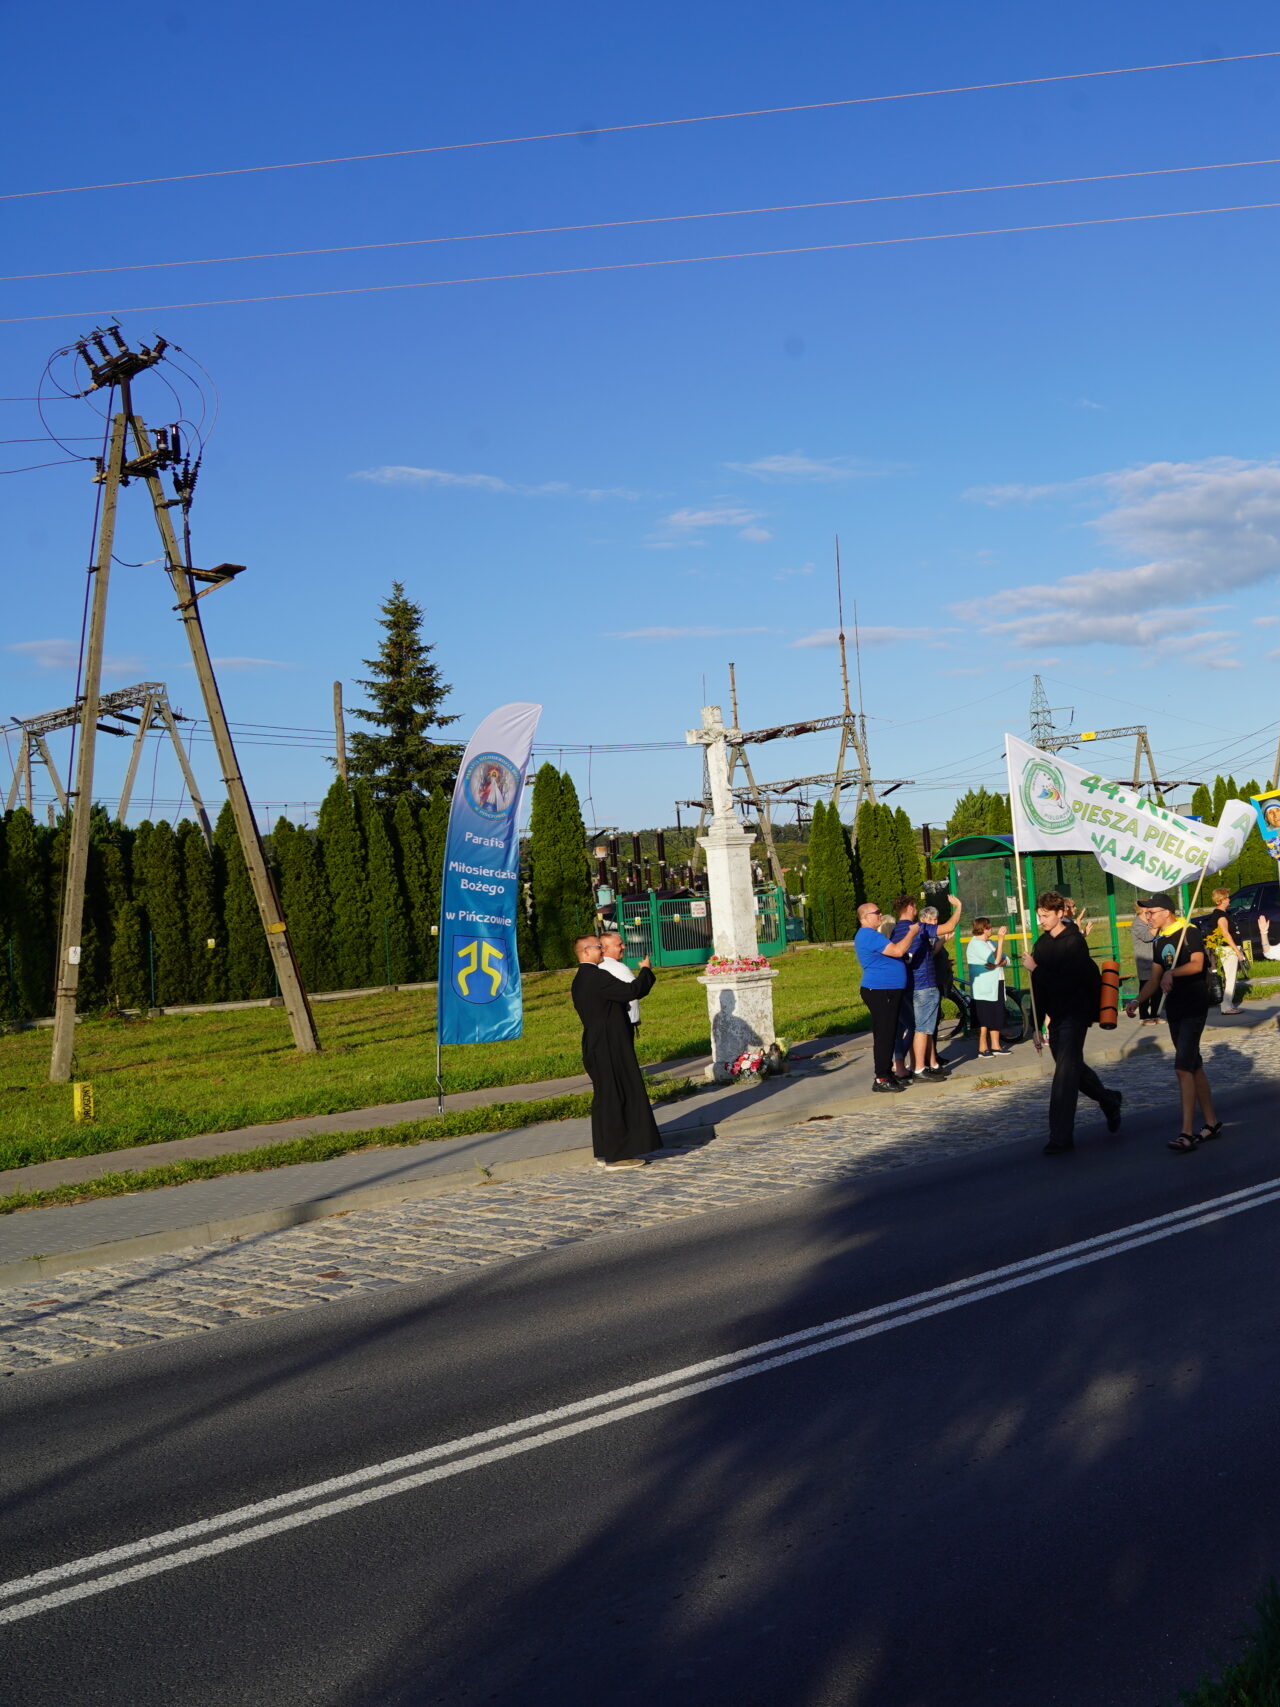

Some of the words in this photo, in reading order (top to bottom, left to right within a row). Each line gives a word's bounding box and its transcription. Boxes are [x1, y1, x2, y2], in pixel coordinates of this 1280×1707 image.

[1080, 775, 1126, 803] 44.
[1072, 800, 1138, 838] PIESZA
[464, 831, 505, 849] Parafia
[1091, 832, 1117, 858] NA
[448, 861, 517, 880] Miłosierdzia
[460, 878, 505, 896] Bożego
[445, 911, 456, 920] w
[458, 910, 512, 926] Pińczowie
